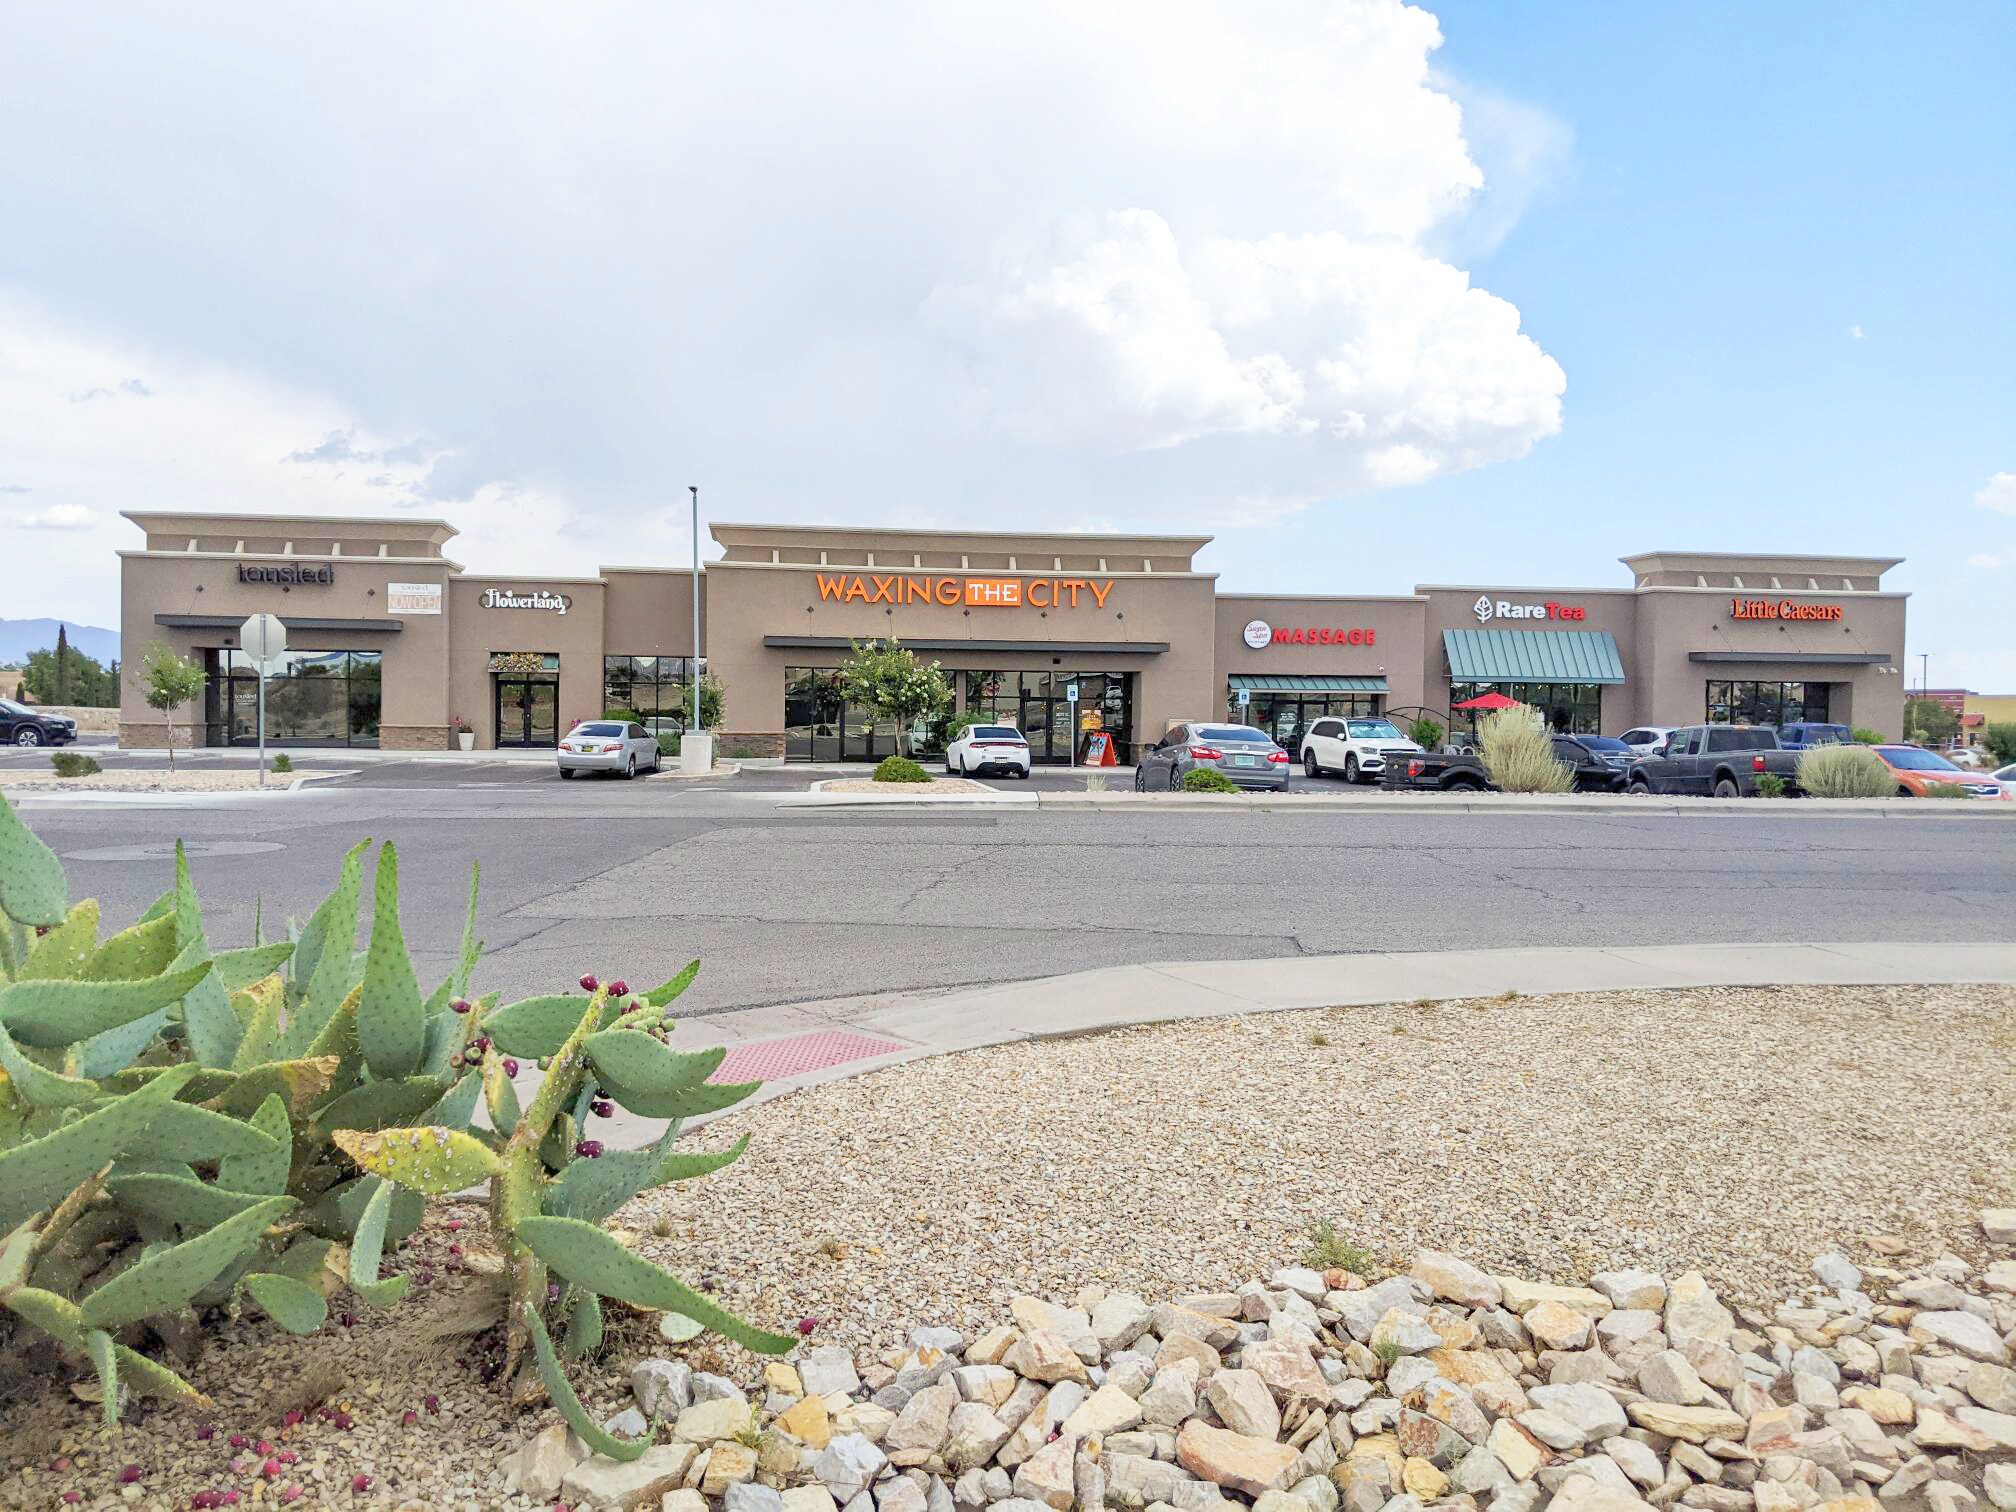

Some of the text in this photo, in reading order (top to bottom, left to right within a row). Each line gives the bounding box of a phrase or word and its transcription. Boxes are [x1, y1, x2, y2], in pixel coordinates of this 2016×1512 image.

[816, 574, 1114, 608] WAXING THE CITY
[388, 595, 442, 609] NOW OPEN
[1731, 599, 1842, 621] Little Caesars
[1273, 627, 1376, 646] MASSAGE
